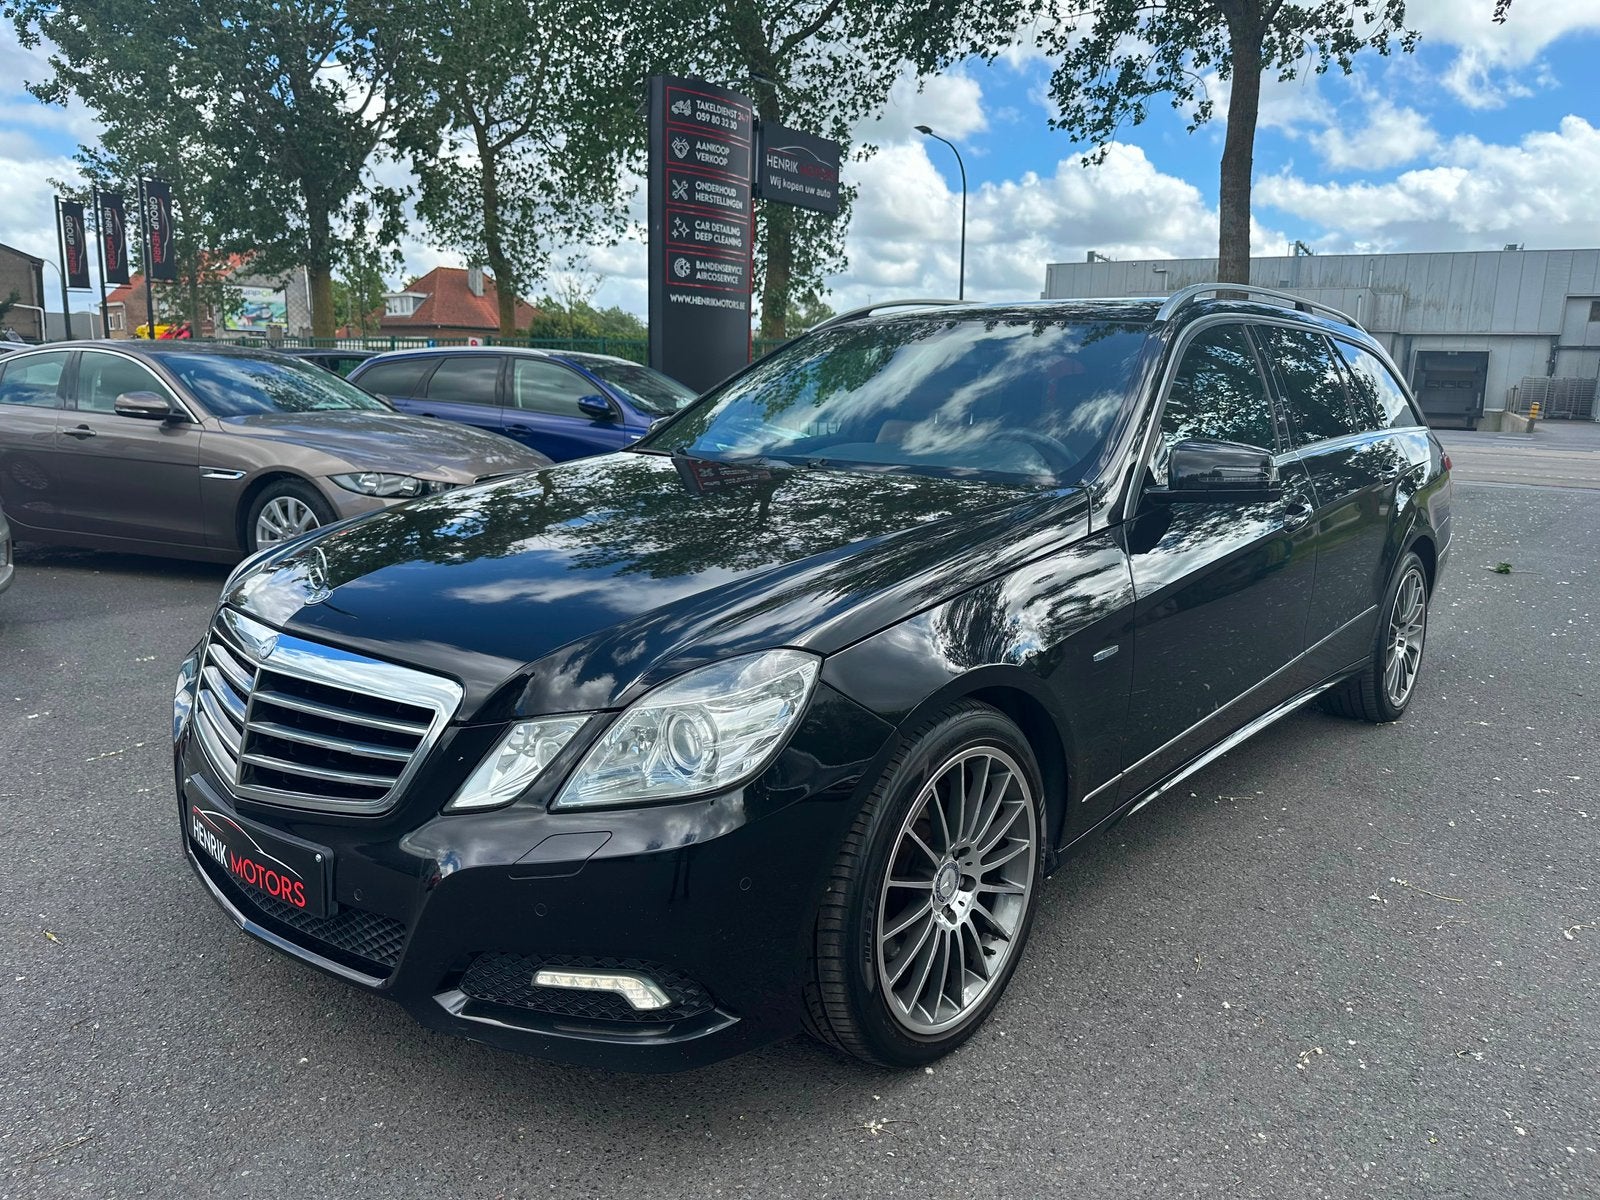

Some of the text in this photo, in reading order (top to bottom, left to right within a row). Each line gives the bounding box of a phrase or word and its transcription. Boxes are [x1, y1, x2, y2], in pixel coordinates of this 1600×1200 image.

[696, 100, 737, 119] TAKELDIENST
[696, 112, 738, 130] 059 80 32 30
[696, 141, 730, 156] AANKOOP
[696, 152, 728, 166] VERKOOP
[766, 154, 798, 174] HENRIK
[695, 181, 737, 197] ONDERHOUD
[770, 175, 831, 199] Wij kopen uw auto
[695, 192, 743, 209] HERSTELLINGEN
[65, 215, 74, 245] GROUP
[150, 196, 162, 263] GROUP HENRIK
[694, 220, 741, 237] CAR DETAILING
[104, 207, 116, 271] HENRIK MOTORS
[694, 231, 742, 247] DEEP CLEANING
[696, 260, 743, 275] BANDENSERVICE
[696, 271, 739, 285] AIRCOSERVICE
[192, 815, 306, 908] HENRIK MOTORS
